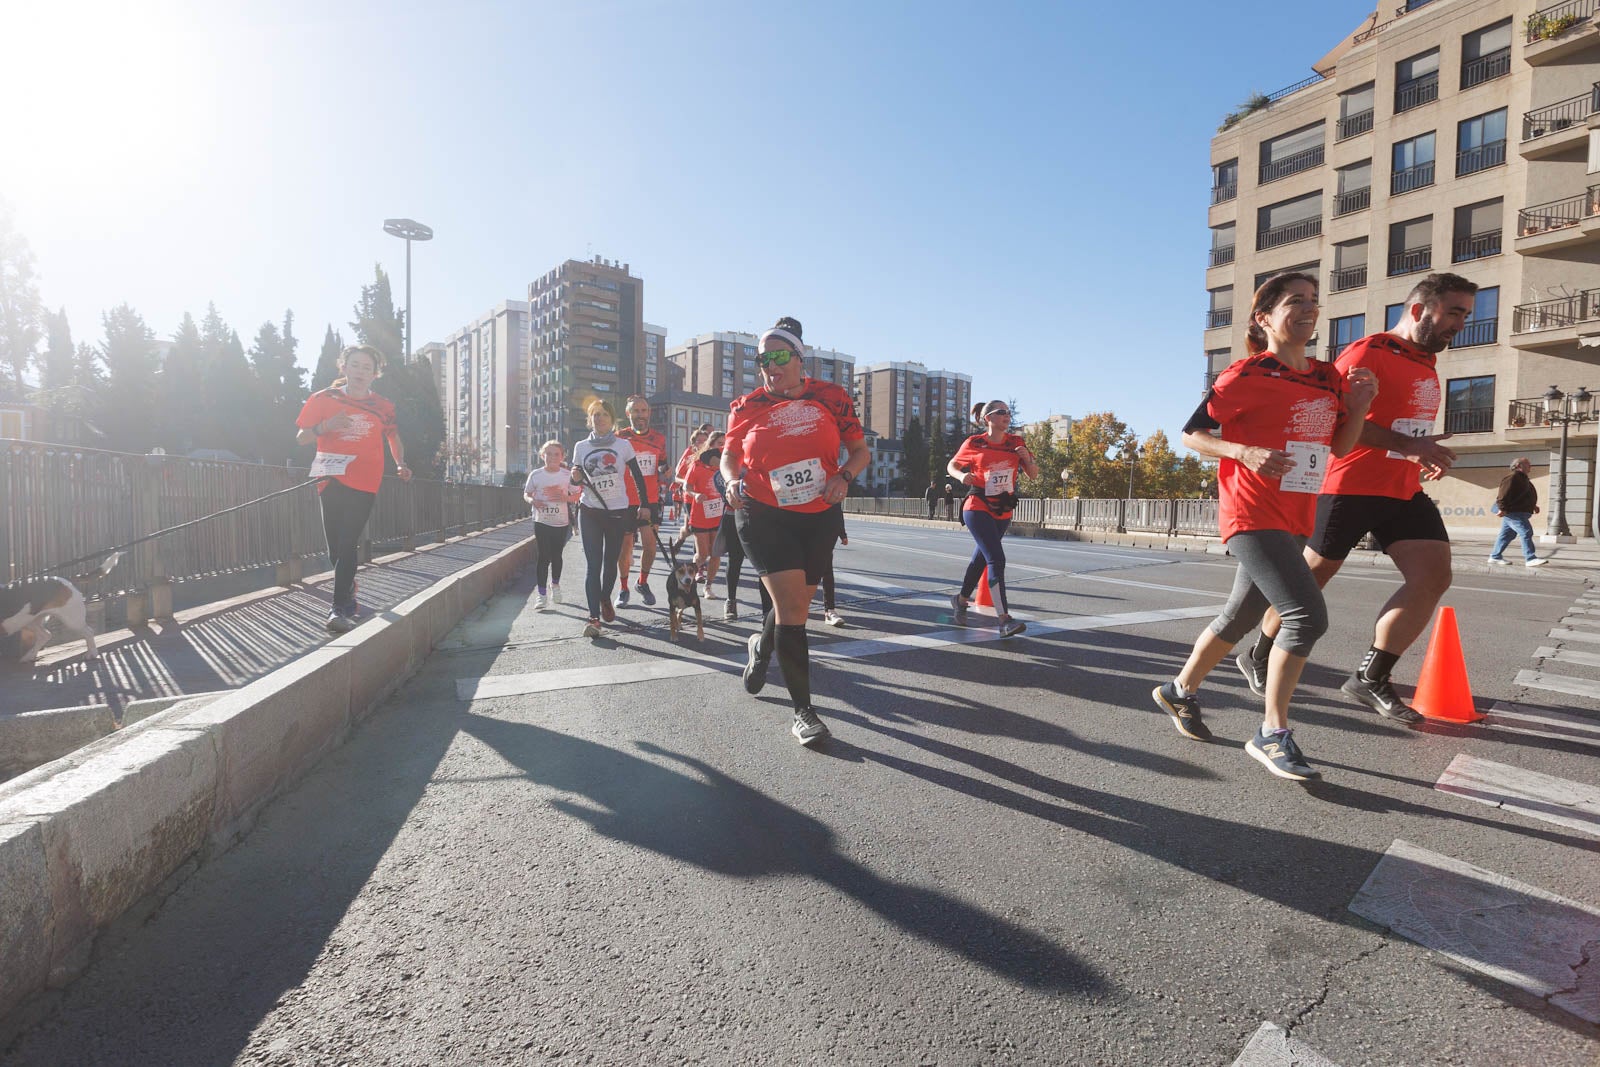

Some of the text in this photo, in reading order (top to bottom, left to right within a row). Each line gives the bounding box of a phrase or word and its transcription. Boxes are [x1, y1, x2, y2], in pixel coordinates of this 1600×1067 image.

[1310, 454, 1317, 469] 9
[784, 469, 813, 487] 382
[992, 475, 1008, 484] 377
[591, 480, 614, 489] 1173
[1440, 507, 1486, 516] DONA
